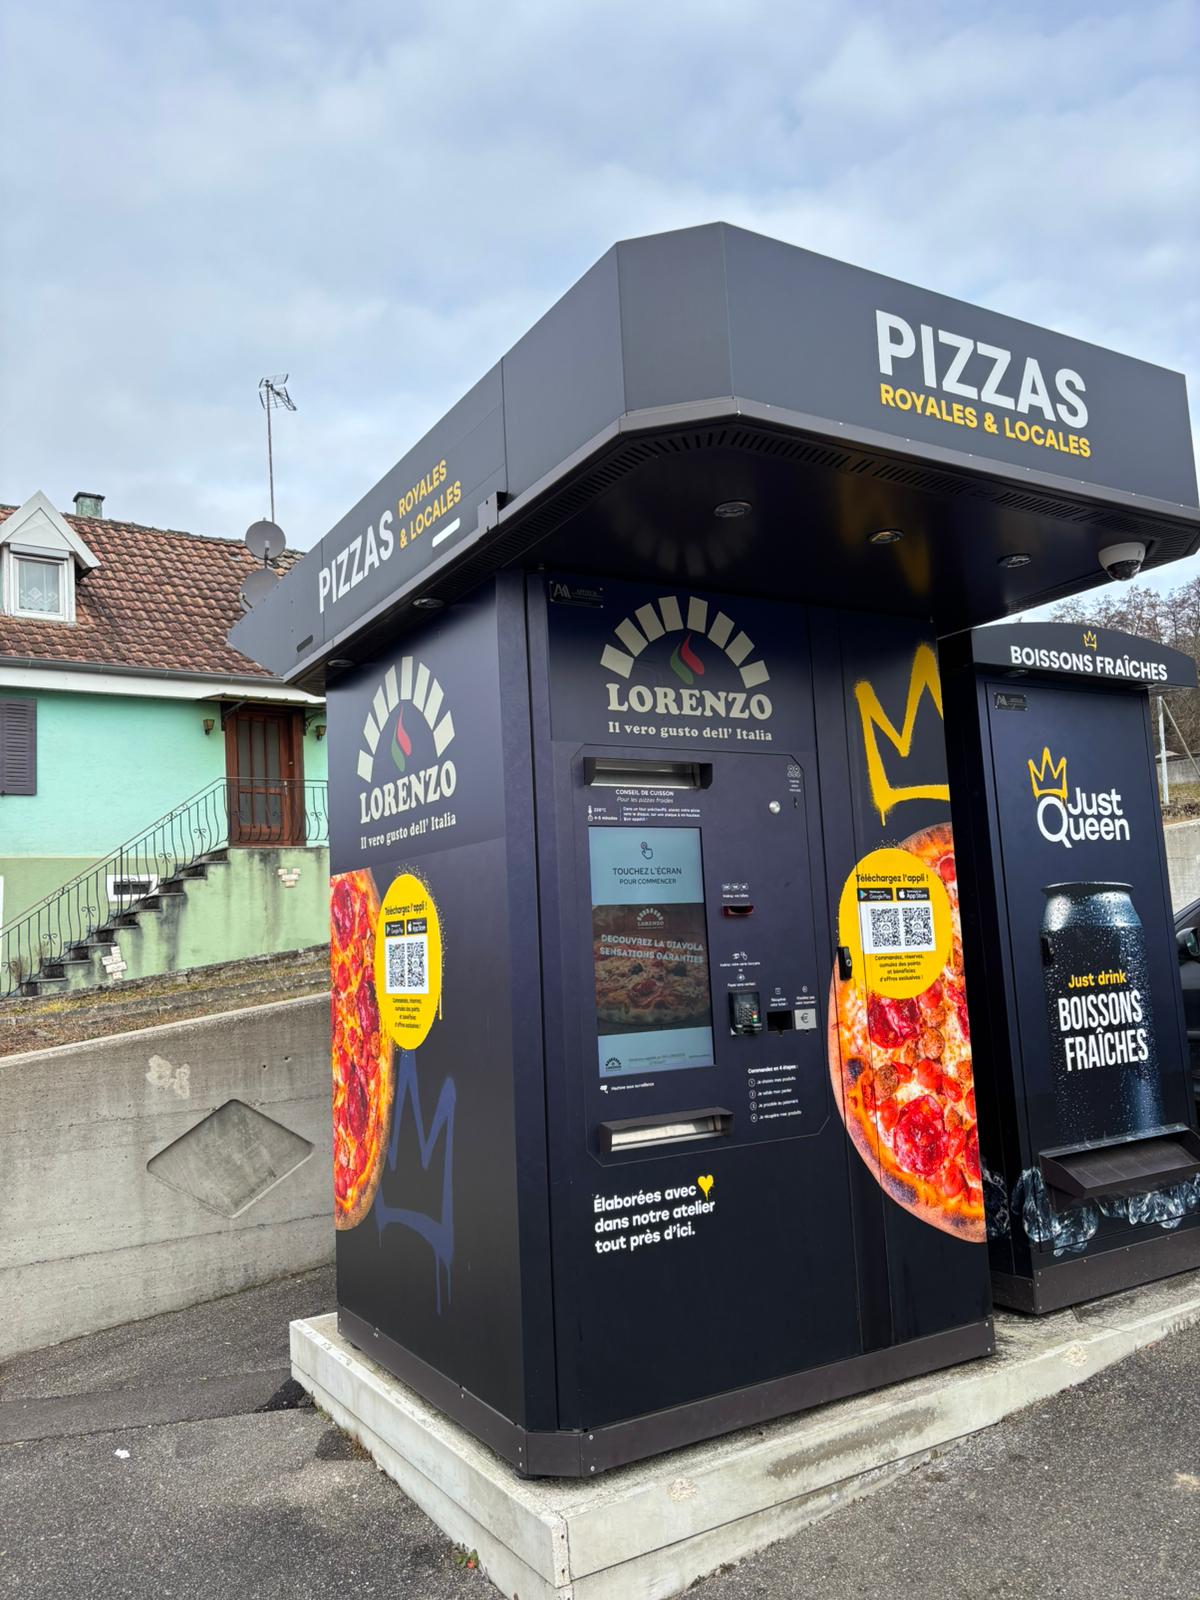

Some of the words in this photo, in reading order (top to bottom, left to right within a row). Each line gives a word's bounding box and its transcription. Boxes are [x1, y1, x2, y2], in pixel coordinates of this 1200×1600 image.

[876, 309, 1089, 429] PIZZAS
[880, 383, 978, 429] ROYALES
[984, 412, 999, 434] &
[1004, 417, 1091, 458] LOCALES
[398, 459, 447, 519] ROYALES
[400, 528, 408, 549] &
[410, 480, 462, 540] LOCALES
[318, 510, 394, 614] PIZZAS
[1010, 645, 1094, 673] BOISSONS
[1096, 654, 1168, 681] FRAÎCHES
[606, 683, 773, 720] LORENZO
[608, 721, 620, 733] Il
[624, 724, 657, 735] vero
[660, 725, 699, 738] gusto
[703, 726, 732, 739] dell'
[736, 728, 773, 741] Italia
[360, 760, 457, 824] LORENZO
[1067, 787, 1124, 816] Just
[360, 836, 367, 849] Il
[368, 834, 385, 848] vero
[386, 826, 408, 847] gusto
[409, 818, 428, 837] dell'
[430, 812, 457, 832] Italia
[1036, 795, 1131, 848] Queen
[613, 867, 649, 875] TOUCHEZ
[856, 873, 901, 884] Téléchargez
[902, 873, 924, 884] l'appli
[600, 947, 655, 960] SENSATIONS
[654, 939, 665, 948] LA
[666, 940, 704, 951] DIAVOLA
[1068, 973, 1095, 989] Just
[1097, 969, 1127, 986] drink
[1057, 989, 1144, 1032] BOISSONS
[1064, 1027, 1149, 1072] FRAÎCHES
[593, 1190, 662, 1212] Élaborées
[664, 1185, 697, 1200] avec
[595, 1217, 629, 1233] dans
[632, 1210, 670, 1226] notre
[672, 1200, 716, 1219] atelier
[595, 1236, 627, 1254] tout
[630, 1229, 661, 1251] près
[664, 1221, 696, 1240] d'ici.
